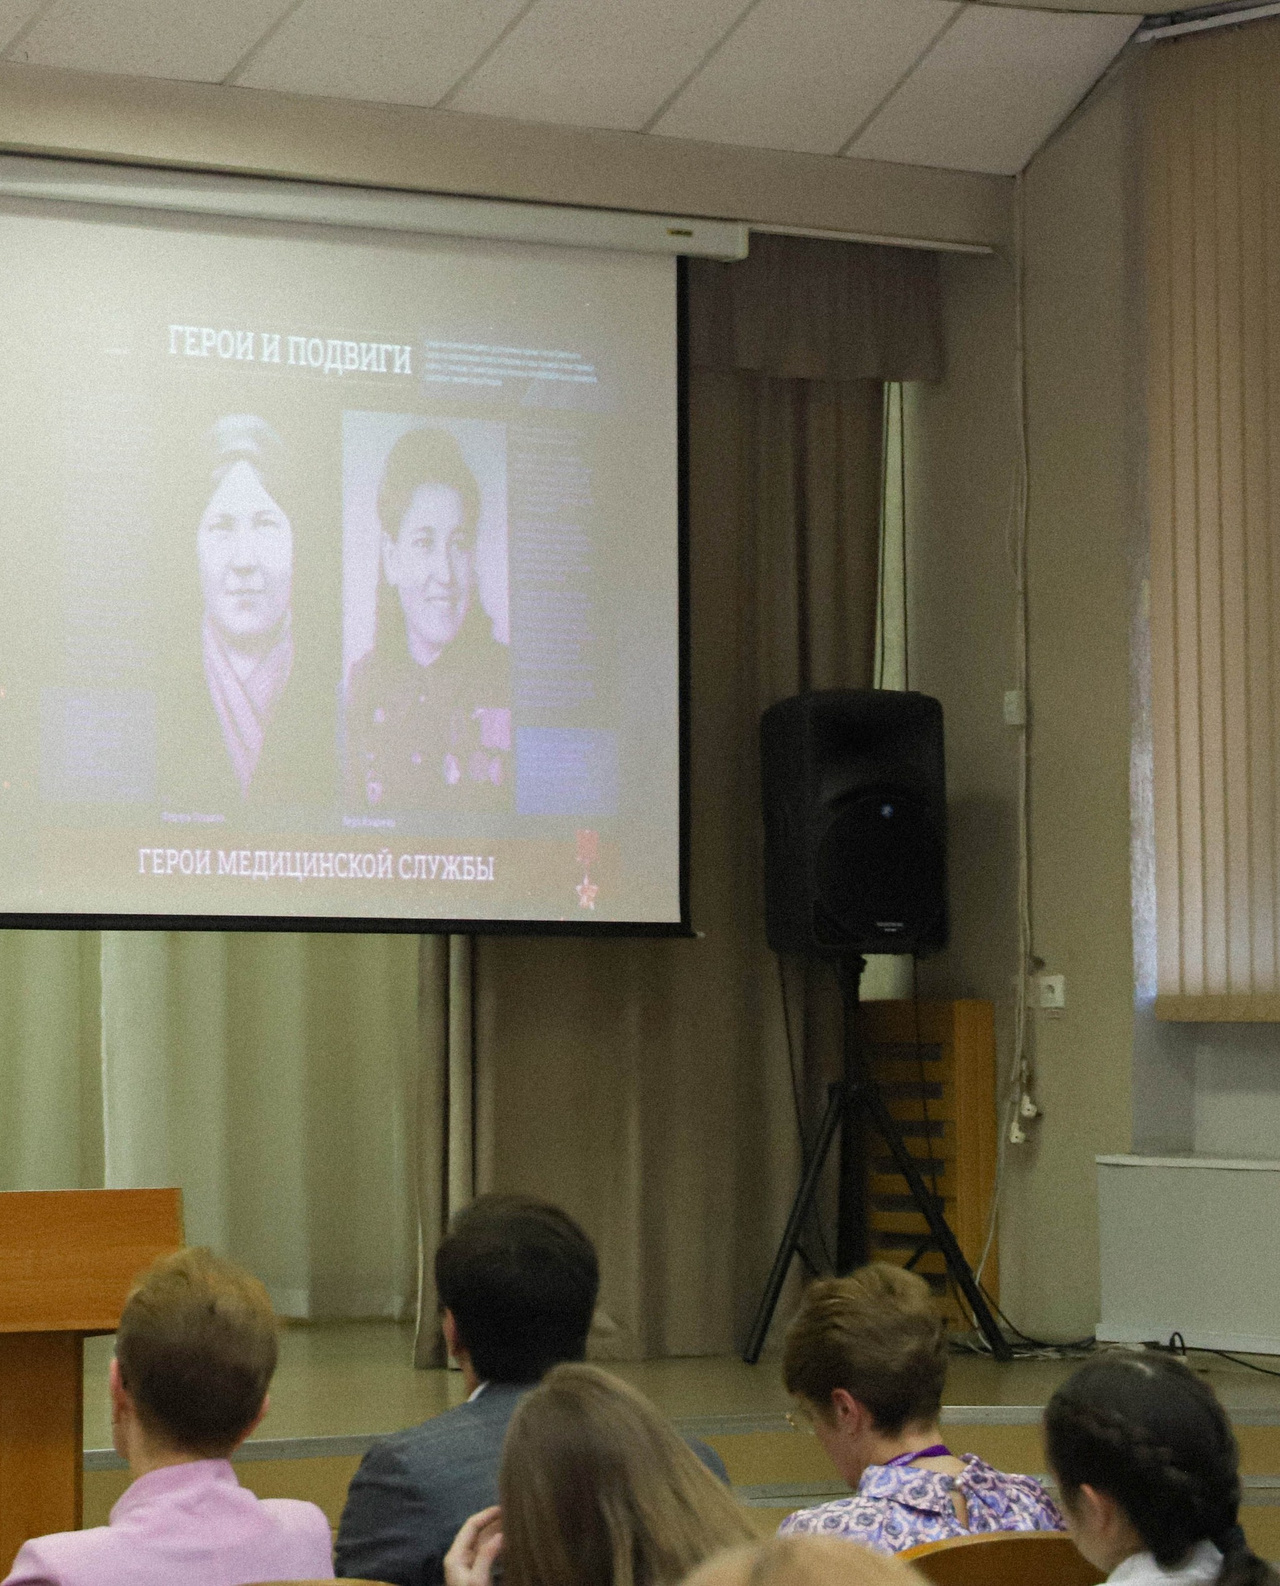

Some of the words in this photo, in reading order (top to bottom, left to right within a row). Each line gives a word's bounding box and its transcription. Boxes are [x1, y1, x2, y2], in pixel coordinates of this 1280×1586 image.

[170, 324, 254, 361] ГЕРОИ
[261, 332, 281, 364] И
[287, 336, 411, 375] ПОДВИГИ
[138, 848, 211, 875] ГЕРОИ
[218, 848, 393, 882] МЕДИЦИНСКОЙ
[398, 853, 495, 881] СЛУЖБЫ
